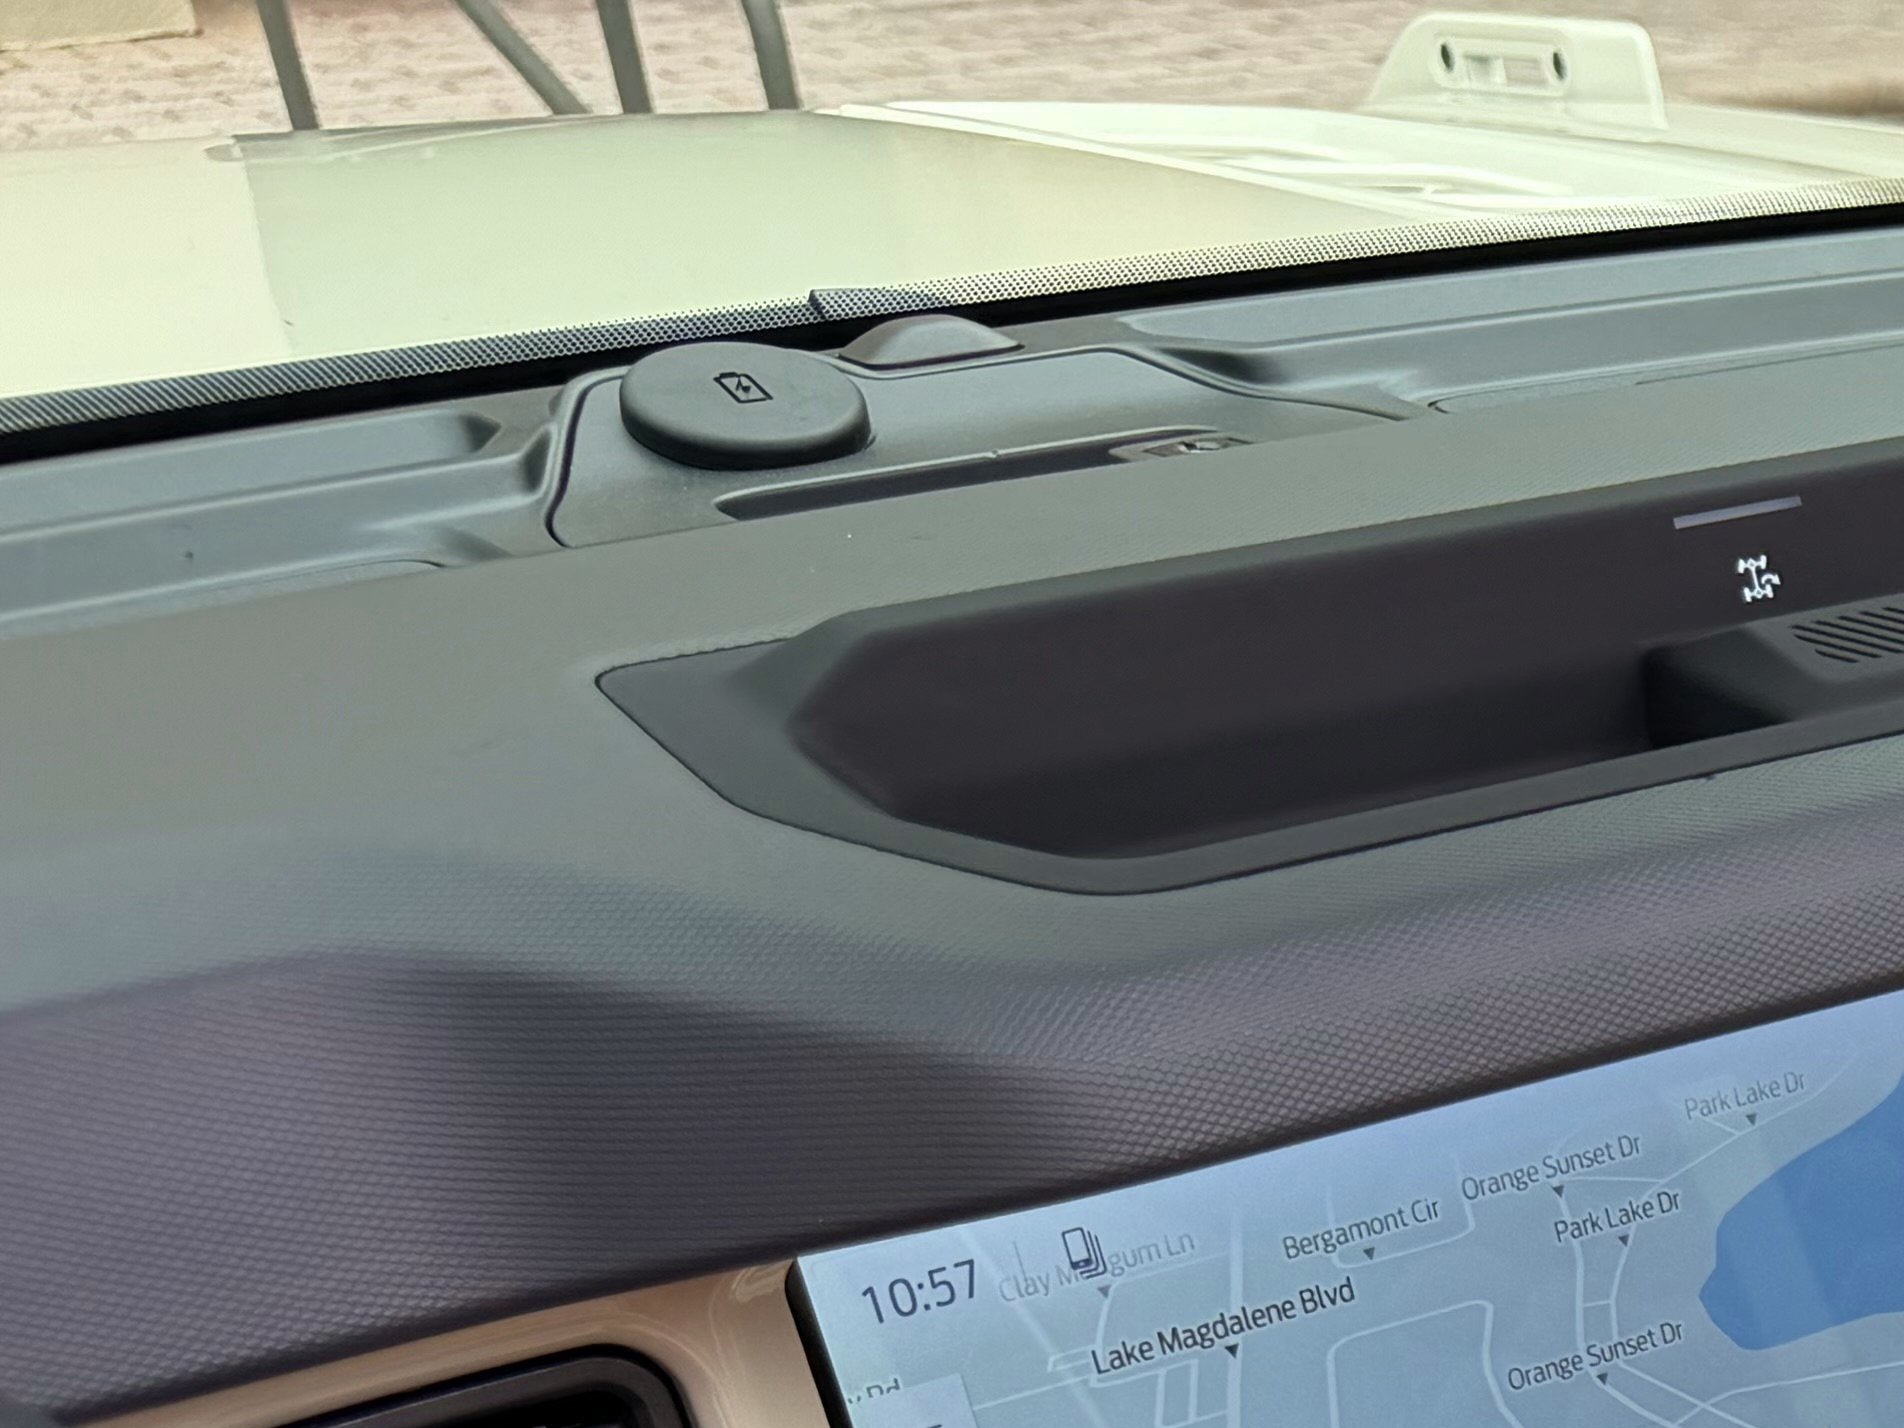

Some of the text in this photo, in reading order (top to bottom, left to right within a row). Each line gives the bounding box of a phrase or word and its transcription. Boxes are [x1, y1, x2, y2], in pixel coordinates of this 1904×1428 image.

[1684, 1070, 1806, 1121] Park Lake Dr
[1461, 1134, 1643, 1202] Orange Sunset Dr
[1283, 1198, 1440, 1260] Bergamont Cir
[1554, 1190, 1682, 1244] Park Lake Dr
[862, 1259, 976, 1323] 10:57
[1000, 1233, 1196, 1302] Clay Mgum Ln
[1091, 1276, 1356, 1376] Lake Magdalene Blvd
[1508, 1320, 1684, 1392] Orange Sunset Dr
